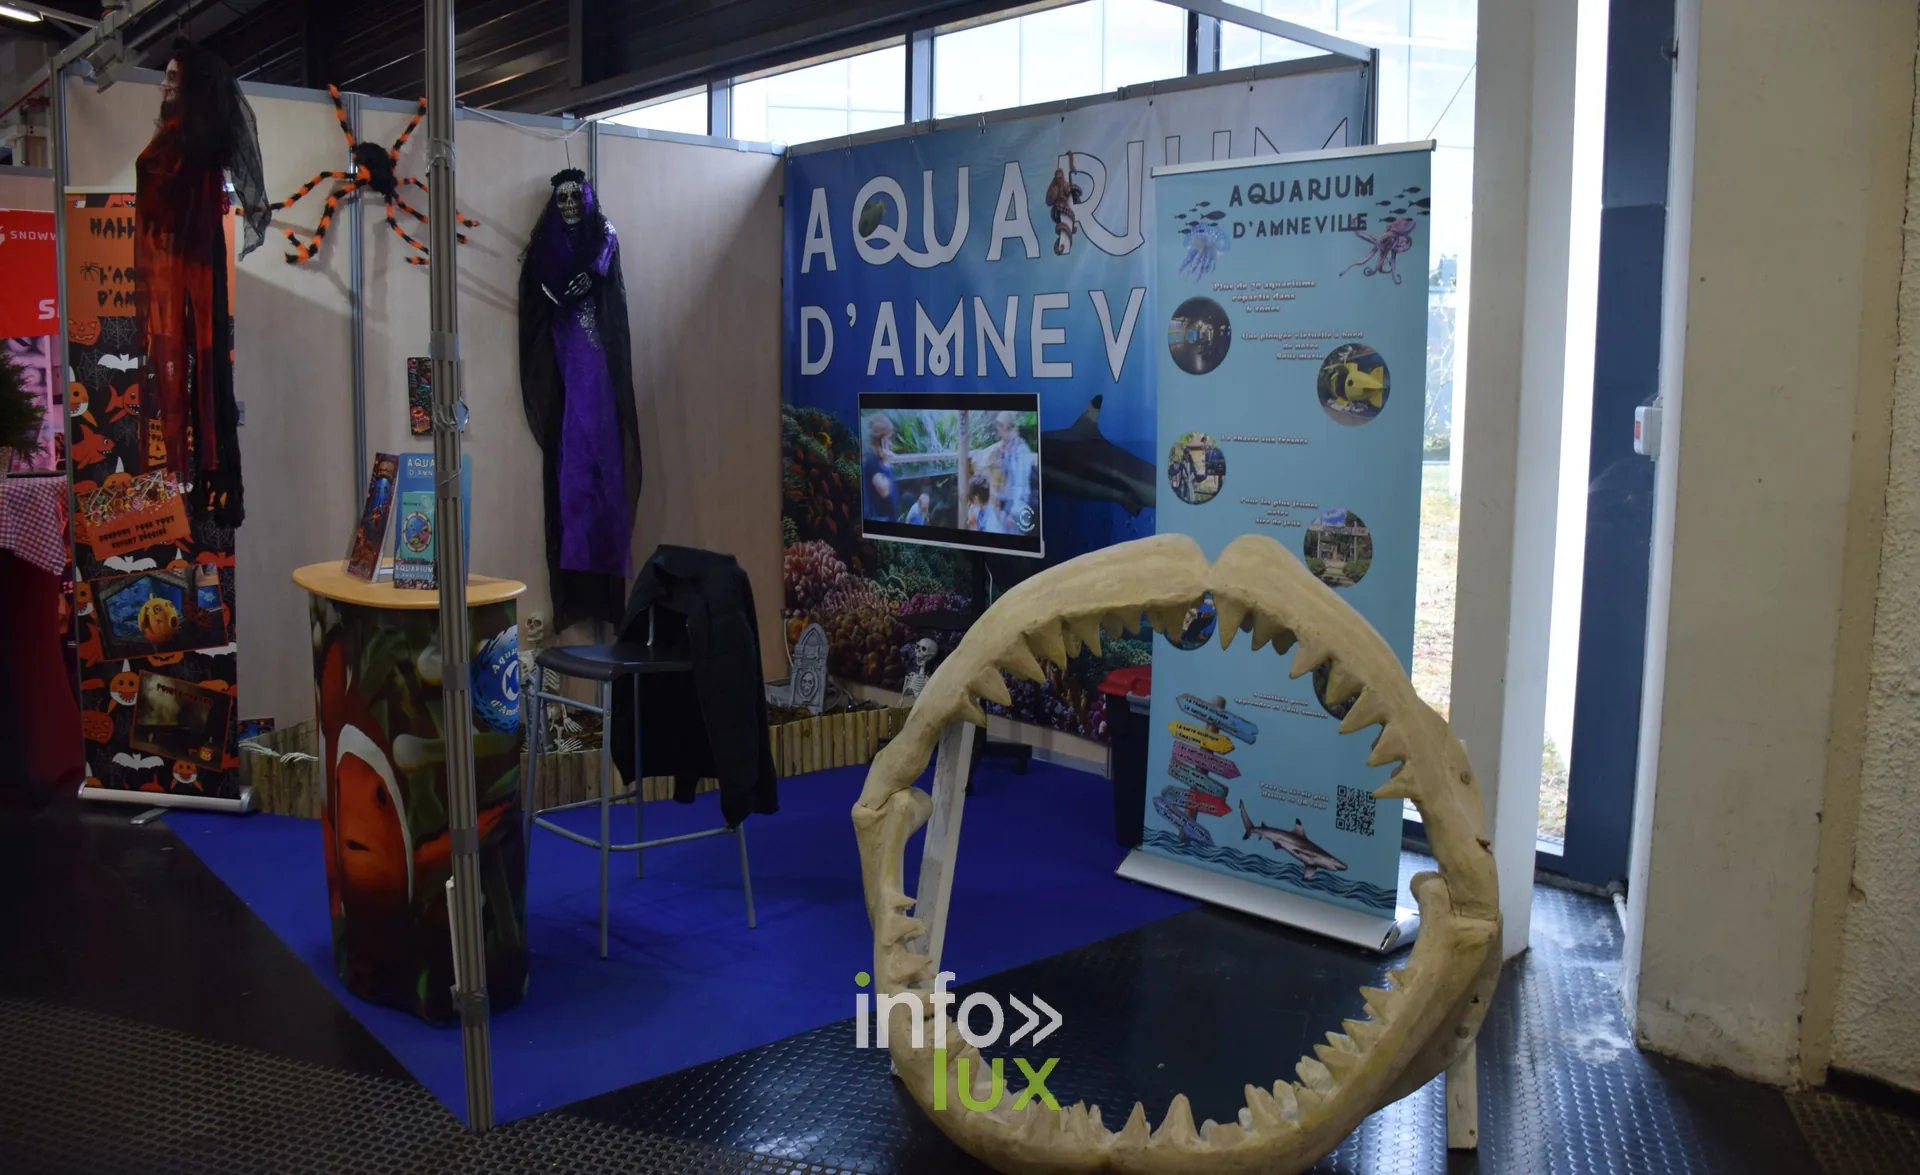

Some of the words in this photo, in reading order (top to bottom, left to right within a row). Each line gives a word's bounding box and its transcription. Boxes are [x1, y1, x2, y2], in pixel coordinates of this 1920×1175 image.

[801, 117, 1348, 273] AQUARI
[1229, 173, 1374, 207] AQUARIUM
[1233, 213, 1368, 239] D'AMNEVILLE
[1236, 281, 1247, 290] de
[1263, 280, 1316, 291] aquariums
[407, 458, 435, 469] AQUA
